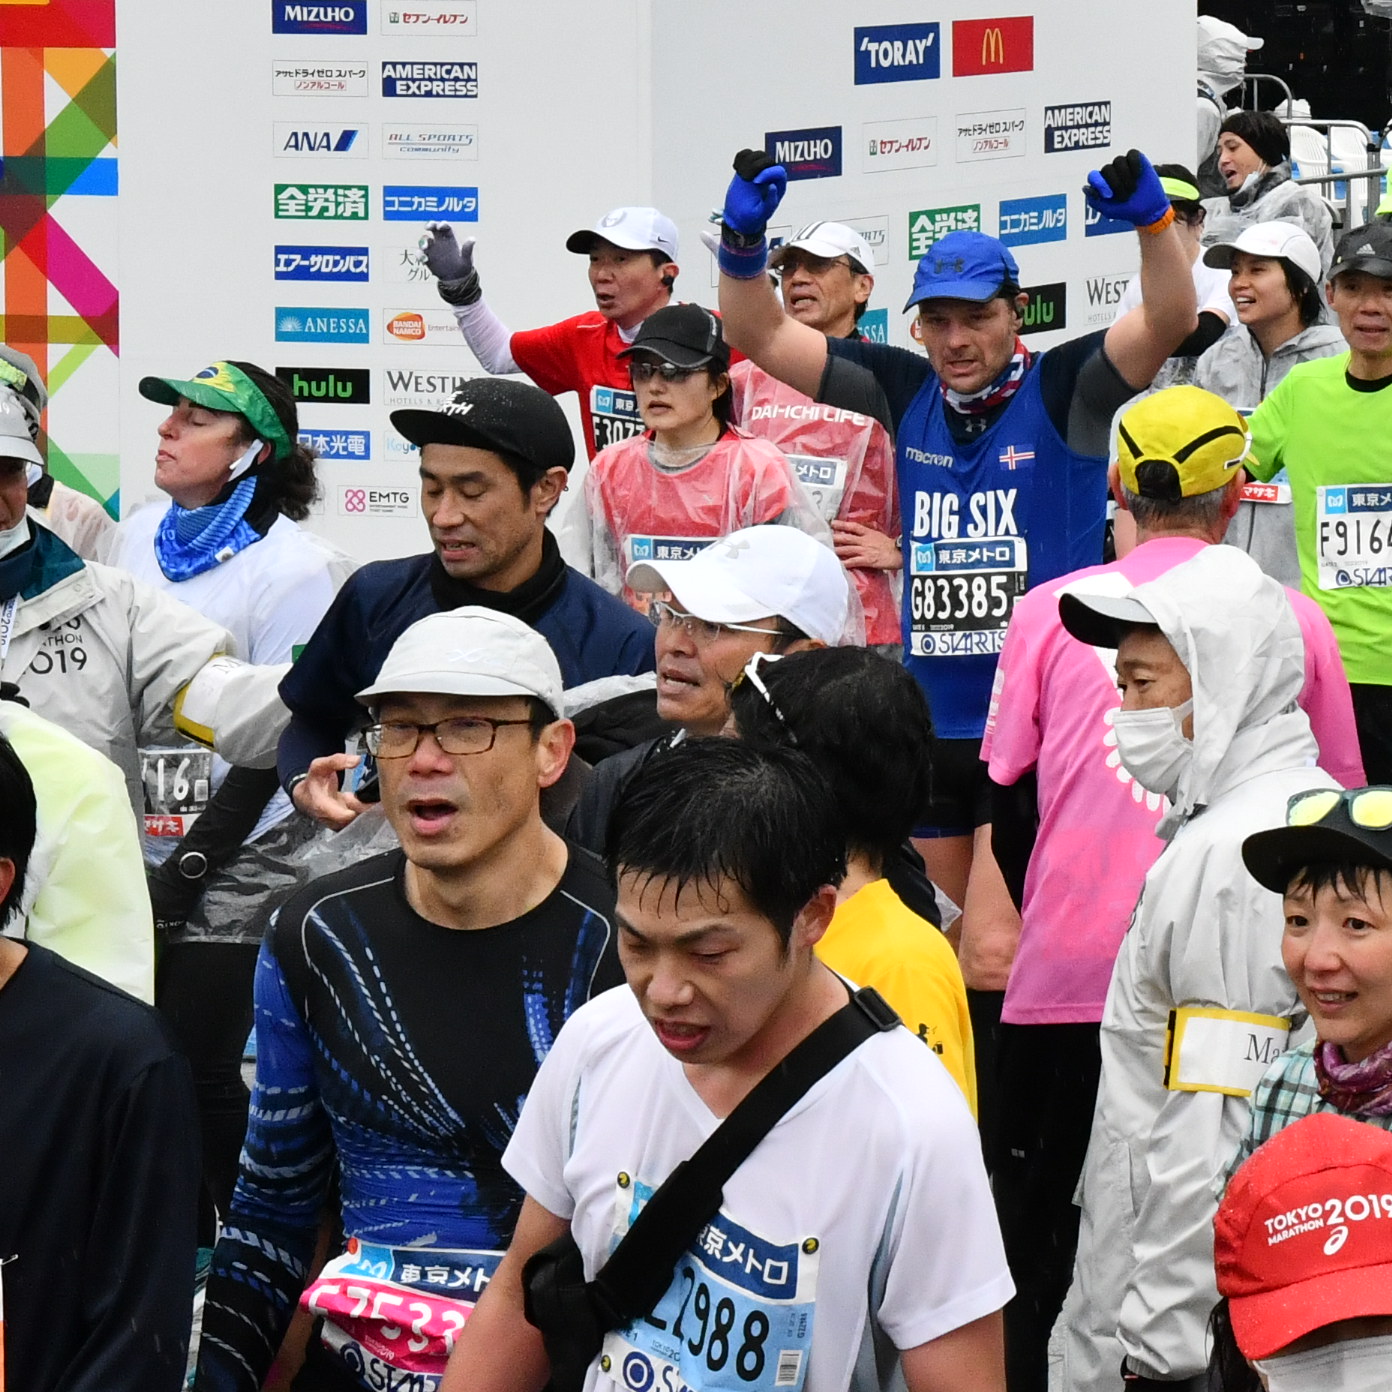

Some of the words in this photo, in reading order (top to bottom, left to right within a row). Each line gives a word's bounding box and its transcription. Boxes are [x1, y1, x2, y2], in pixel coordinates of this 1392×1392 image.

[284, 5, 354, 22] MIZUHO
[334, 69, 366, 78] スパーク
[383, 64, 477, 79] AMERICAN
[296, 81, 345, 91] ノンアルコール
[396, 81, 478, 95] EXPRESS
[1044, 103, 1110, 128] AMERICAN
[284, 132, 332, 152] ANA
[388, 133, 413, 142] ALL
[419, 134, 474, 145] SPORTS
[973, 138, 1010, 151] ノンアルコール
[1053, 125, 1111, 149] EXPRESS
[400, 145, 459, 154] community
[775, 138, 832, 163] MIZUHO
[277, 188, 366, 218] 全労済
[385, 196, 476, 212] コニカミノルタ
[1000, 207, 1066, 235] コニカミノルタ
[276, 255, 368, 272] エアーサロンパス
[1022, 298, 1054, 325] ulu
[305, 318, 366, 334] ANESSA
[393, 321, 422, 329] BANDAI
[393, 328, 422, 337] NAMCO
[293, 375, 353, 397] hulu
[752, 405, 820, 421] DAI-ICHI
[823, 407, 866, 426] LIFE
[297, 433, 366, 456] 日本光電
[906, 446, 953, 468] macron
[370, 492, 409, 503] EMTG
[913, 491, 960, 539] BIG
[967, 488, 1018, 538] SIX
[938, 547, 1010, 564] 東京メトロ
[911, 574, 1008, 620] G83385
[1265, 1203, 1323, 1234] TOKYO
[1267, 1218, 1324, 1246] MARATHON
[401, 1263, 491, 1293] 東京メト
